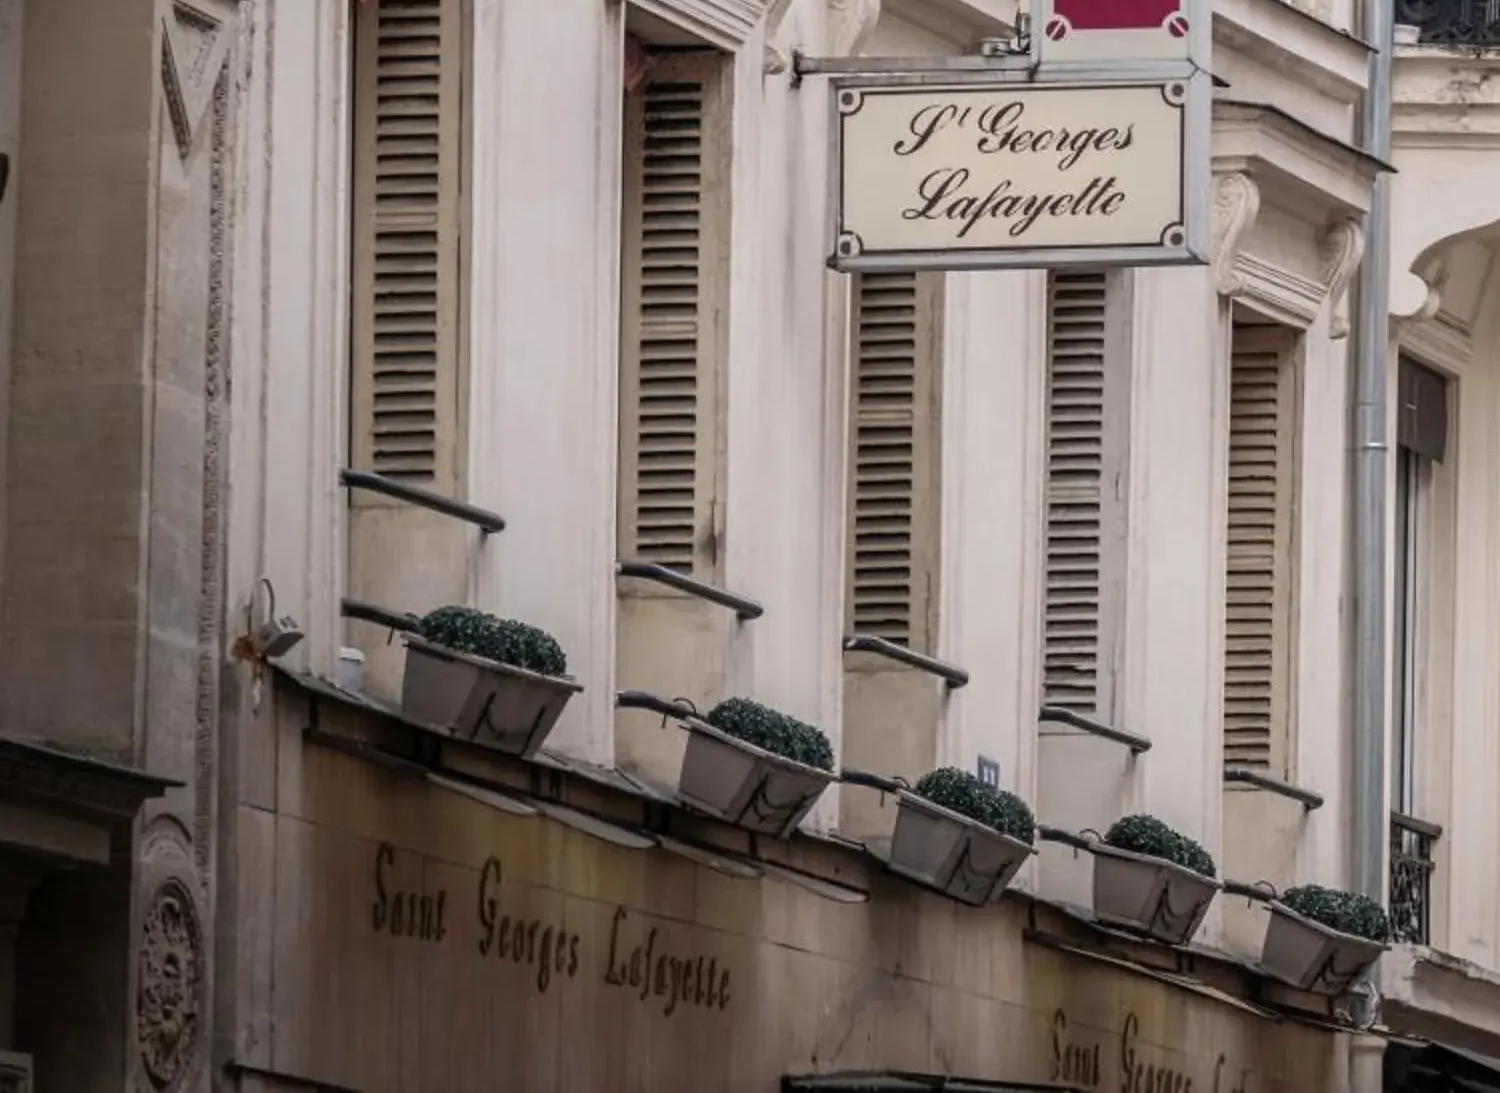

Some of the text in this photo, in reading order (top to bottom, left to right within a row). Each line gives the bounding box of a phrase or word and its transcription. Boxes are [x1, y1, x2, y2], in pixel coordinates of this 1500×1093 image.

[977, 101, 1134, 170] Georges
[901, 167, 1126, 238] Lafayette
[372, 842, 731, 1017] Saint Georges Lafayette
